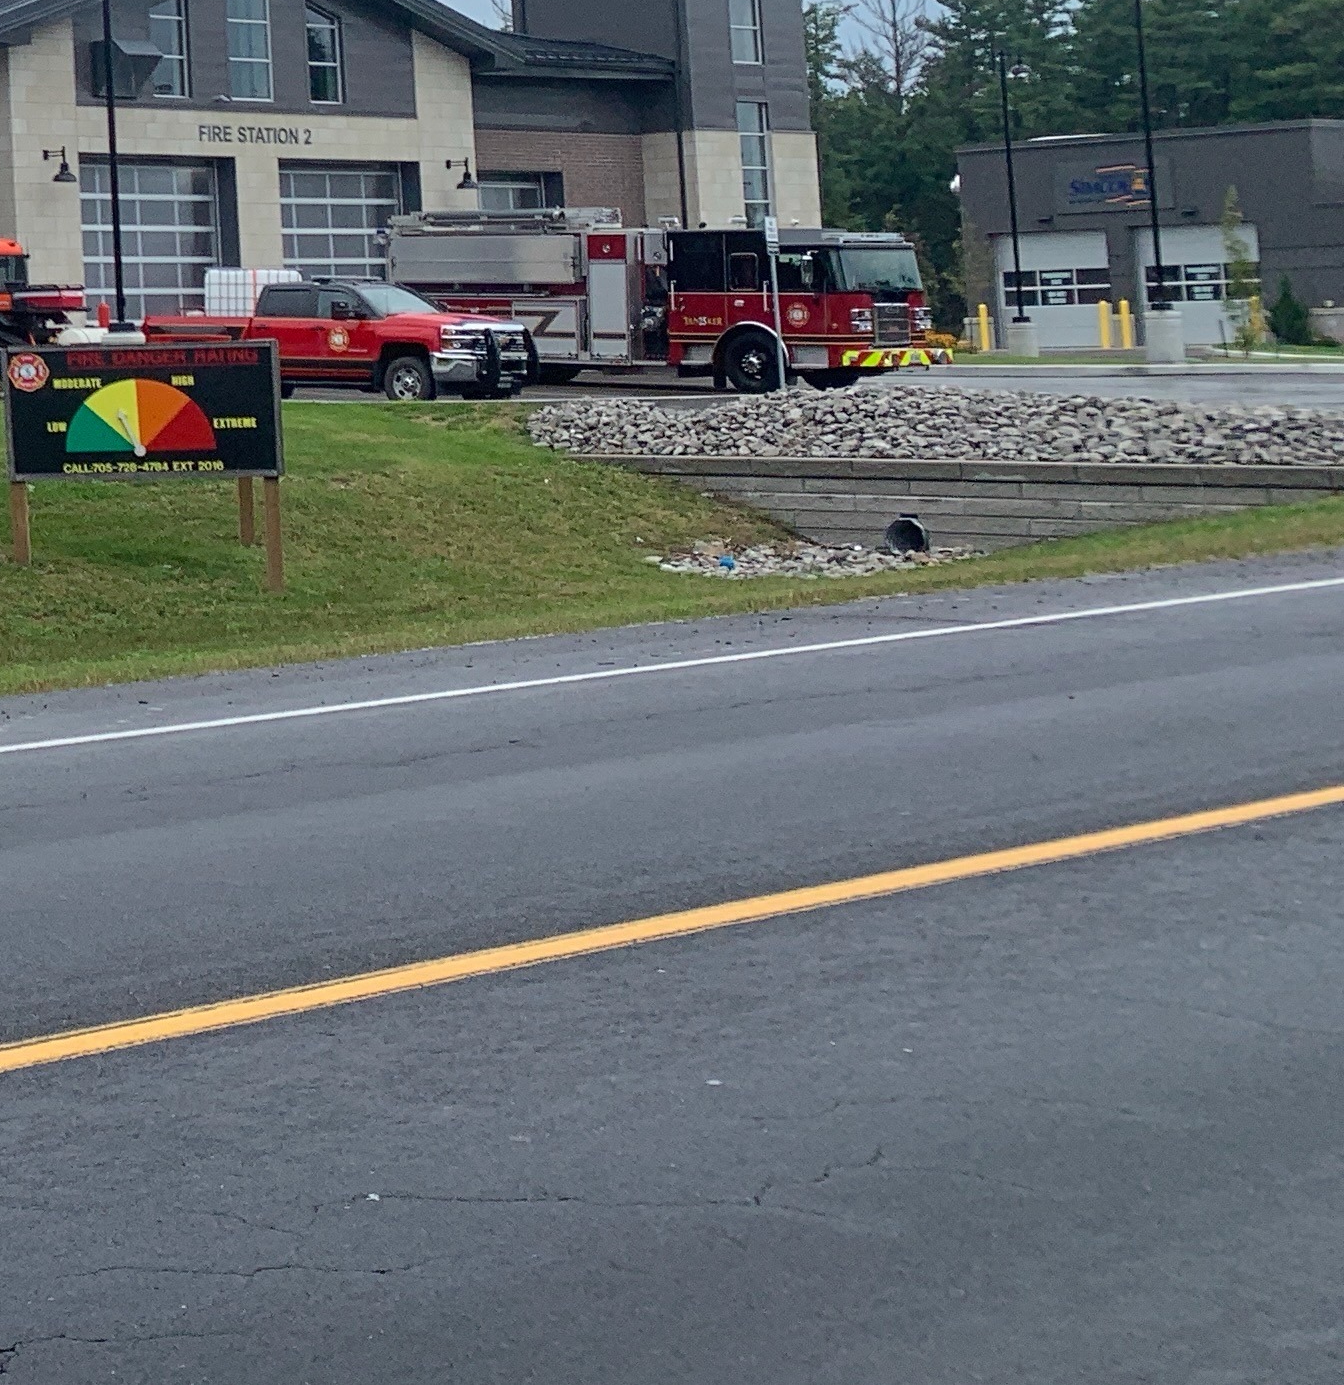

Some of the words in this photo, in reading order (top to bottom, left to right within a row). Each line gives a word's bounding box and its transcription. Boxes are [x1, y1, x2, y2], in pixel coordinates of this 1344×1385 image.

[198, 125, 232, 143] FIRE
[237, 126, 299, 144] STATION
[303, 129, 312, 145] 2
[53, 378, 102, 389] MODERATE
[171, 375, 195, 386] HIGH
[47, 421, 67, 433] LOW
[213, 417, 258, 429] EXTREME
[172, 460, 195, 472] EXT
